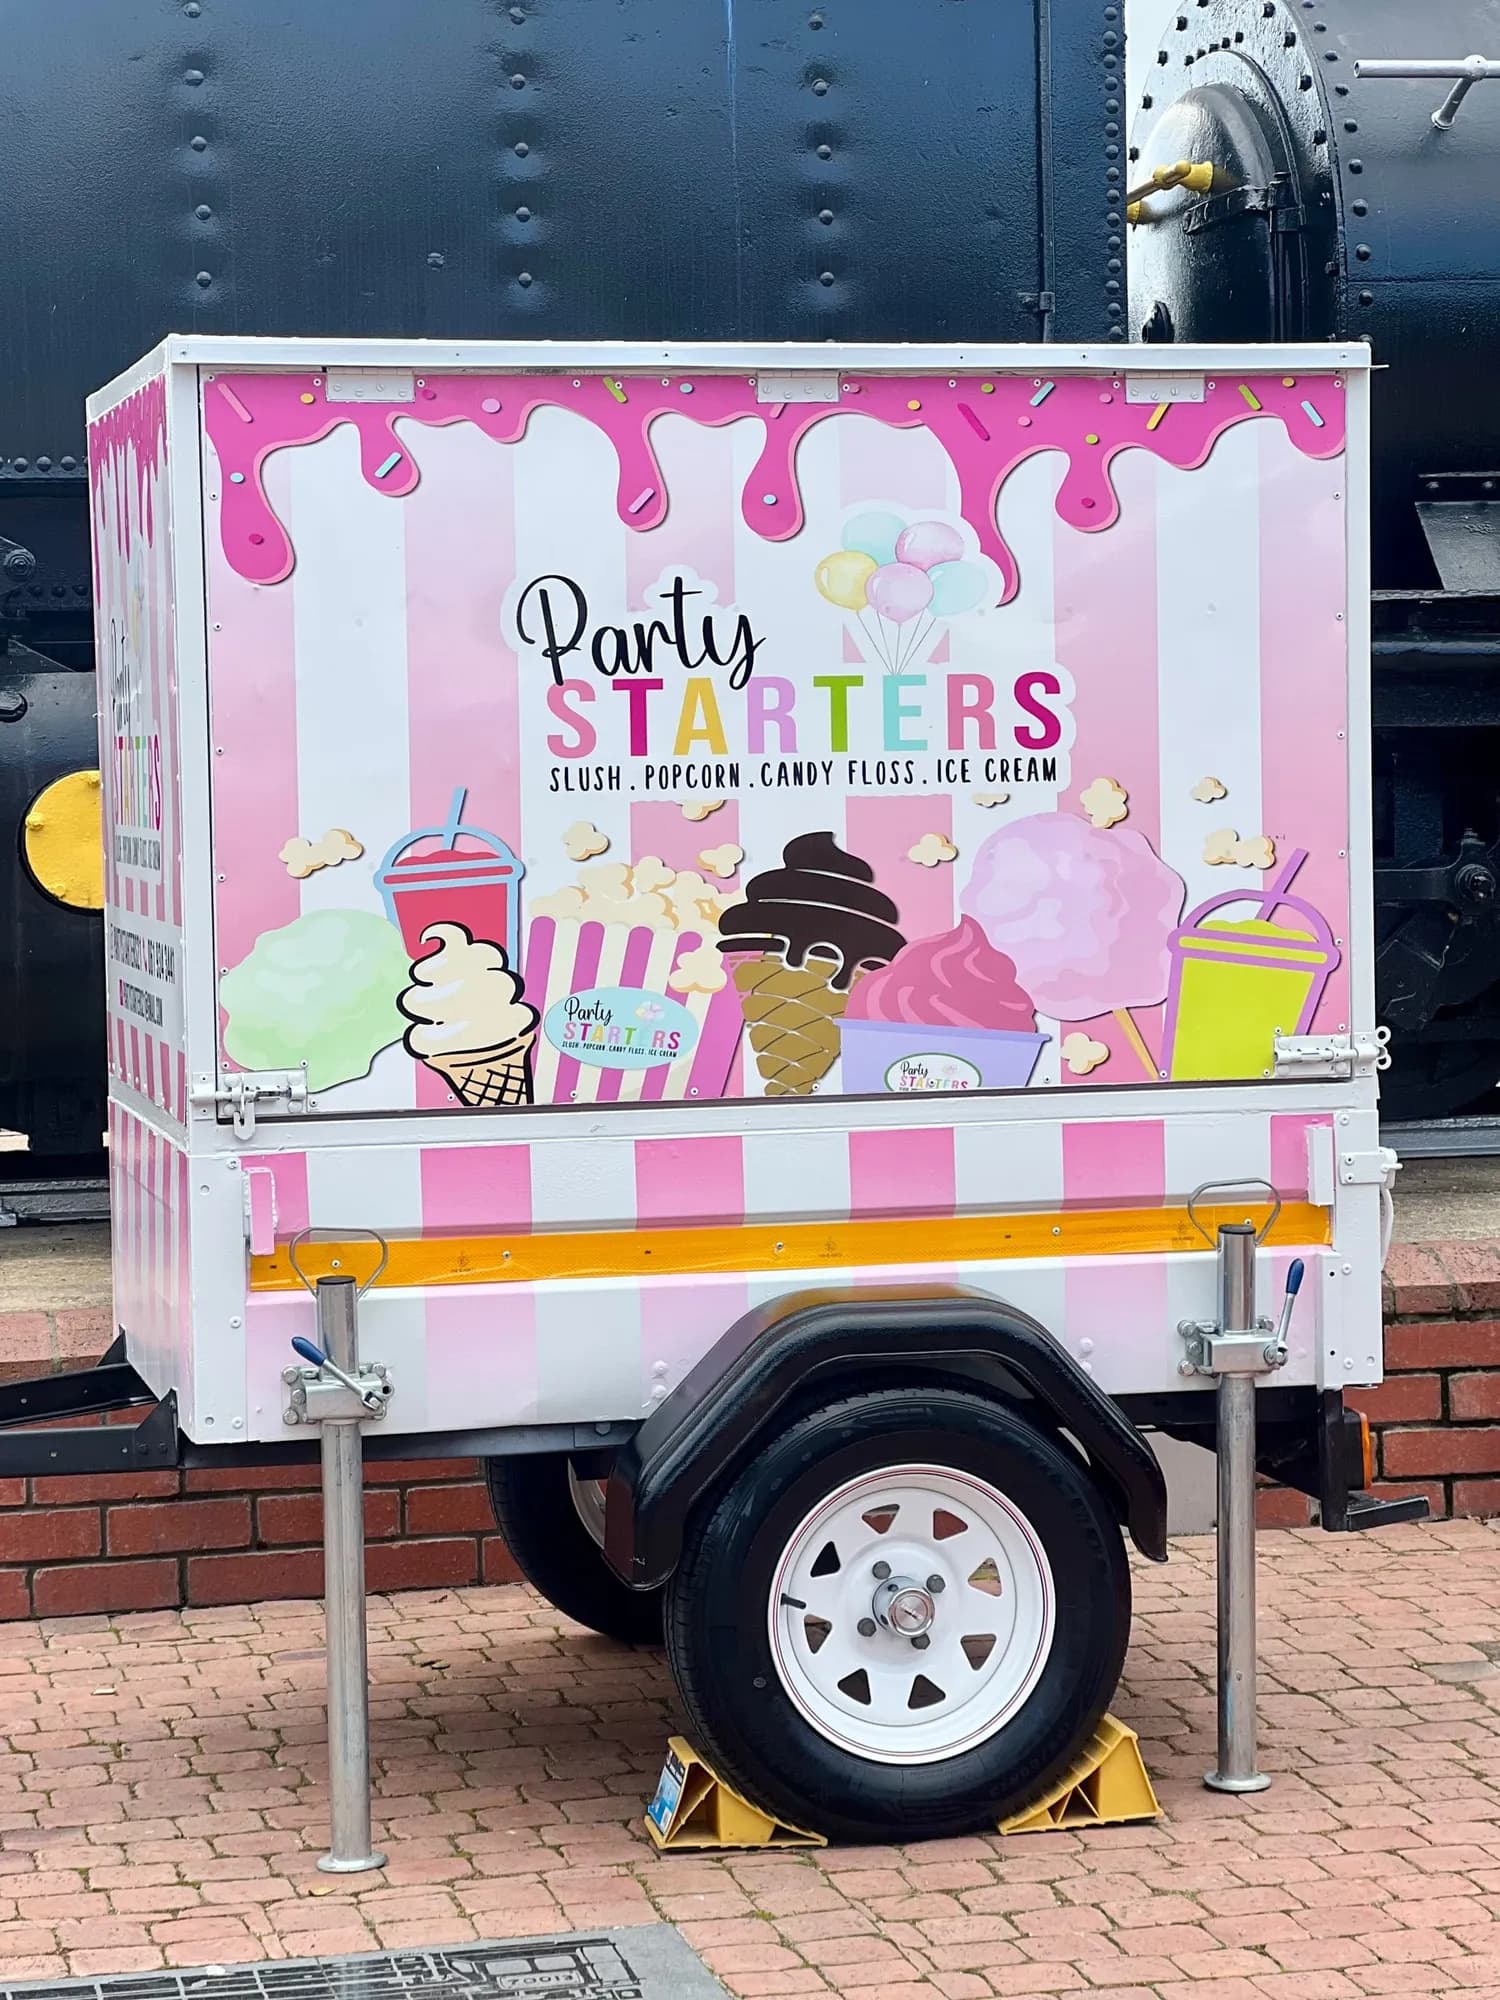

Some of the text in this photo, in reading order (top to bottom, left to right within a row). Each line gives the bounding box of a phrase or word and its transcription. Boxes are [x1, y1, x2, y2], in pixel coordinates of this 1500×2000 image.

[517, 575, 766, 690] Party
[546, 672, 1061, 758] STARTERS
[114, 735, 161, 830] STARTERS
[549, 757, 1057, 792] SLUSH POPCORN CANDY FLOSS ICE CREAM
[564, 996, 613, 1026] Party
[900, 1060, 928, 1078] Party
